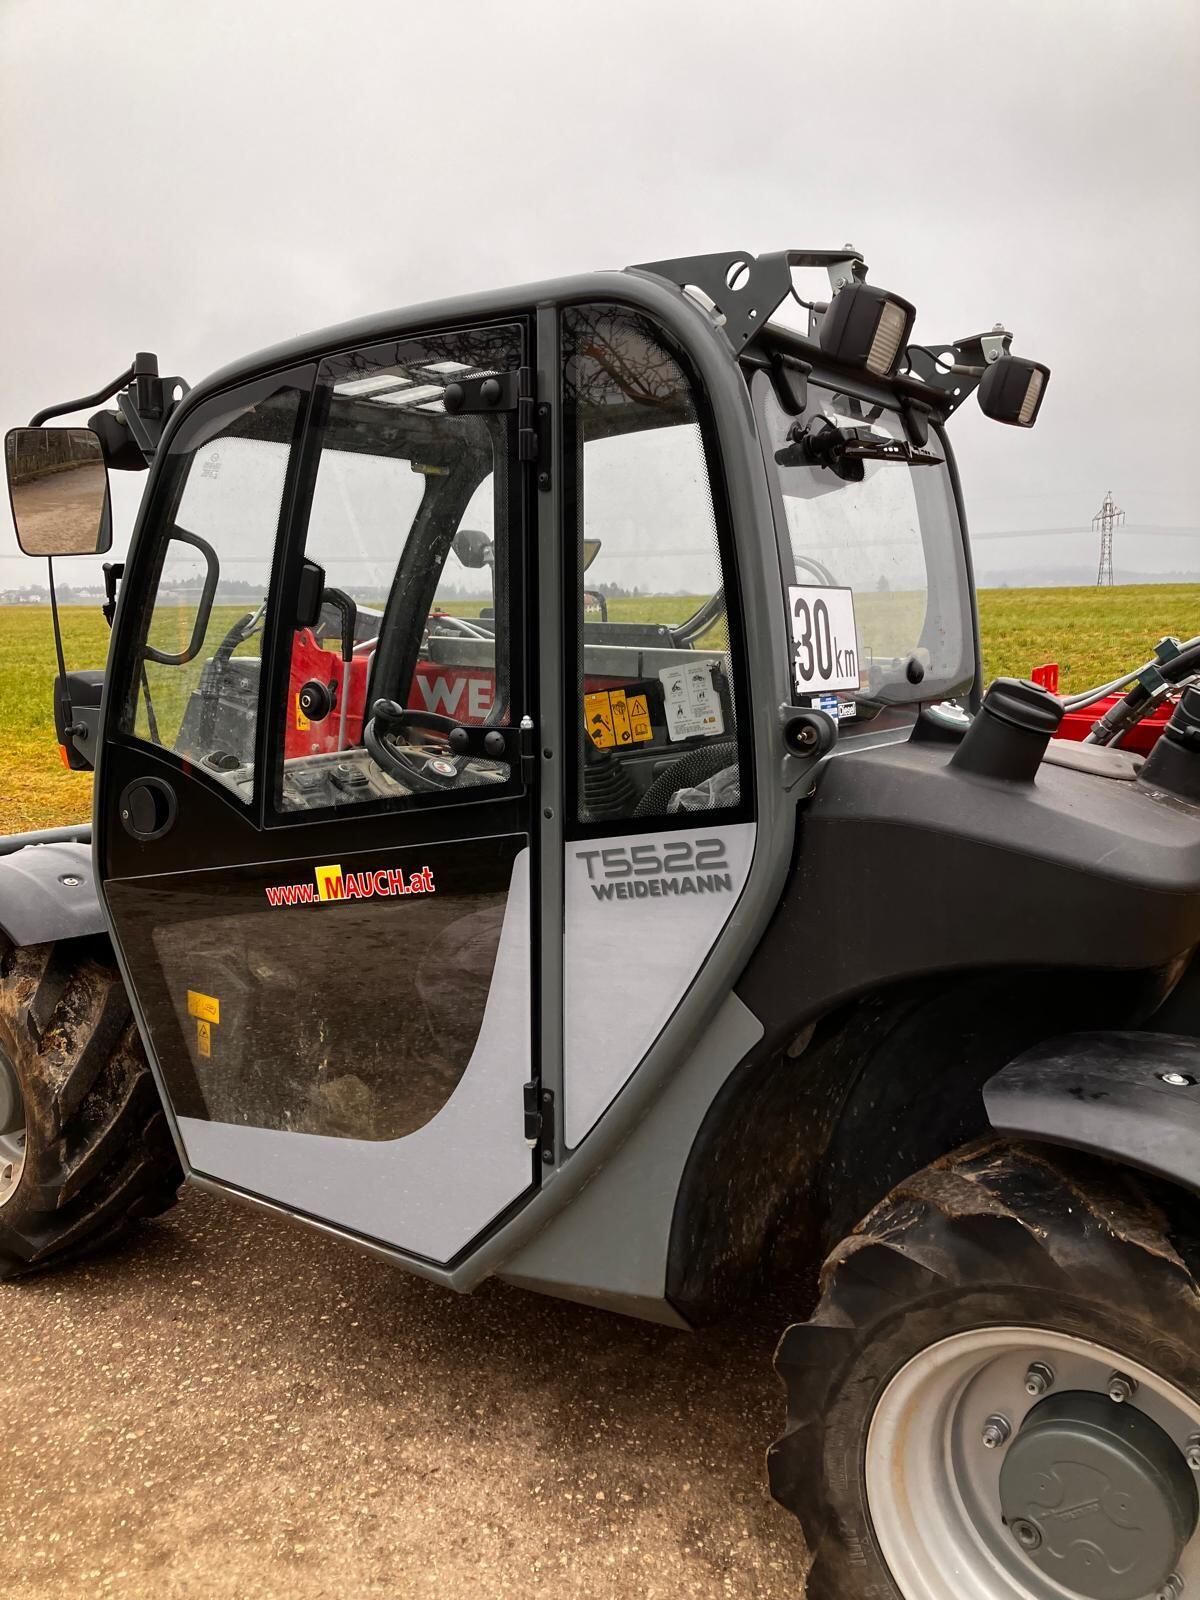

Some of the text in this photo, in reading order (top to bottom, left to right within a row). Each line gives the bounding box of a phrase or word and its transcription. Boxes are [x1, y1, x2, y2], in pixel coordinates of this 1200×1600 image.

[794, 598, 856, 681] 30 km
[839, 702, 856, 717] Diesel
[576, 838, 728, 879] T5522
[266, 866, 435, 906] www.MAUCH.at
[591, 873, 732, 901] WEIDEMANN
